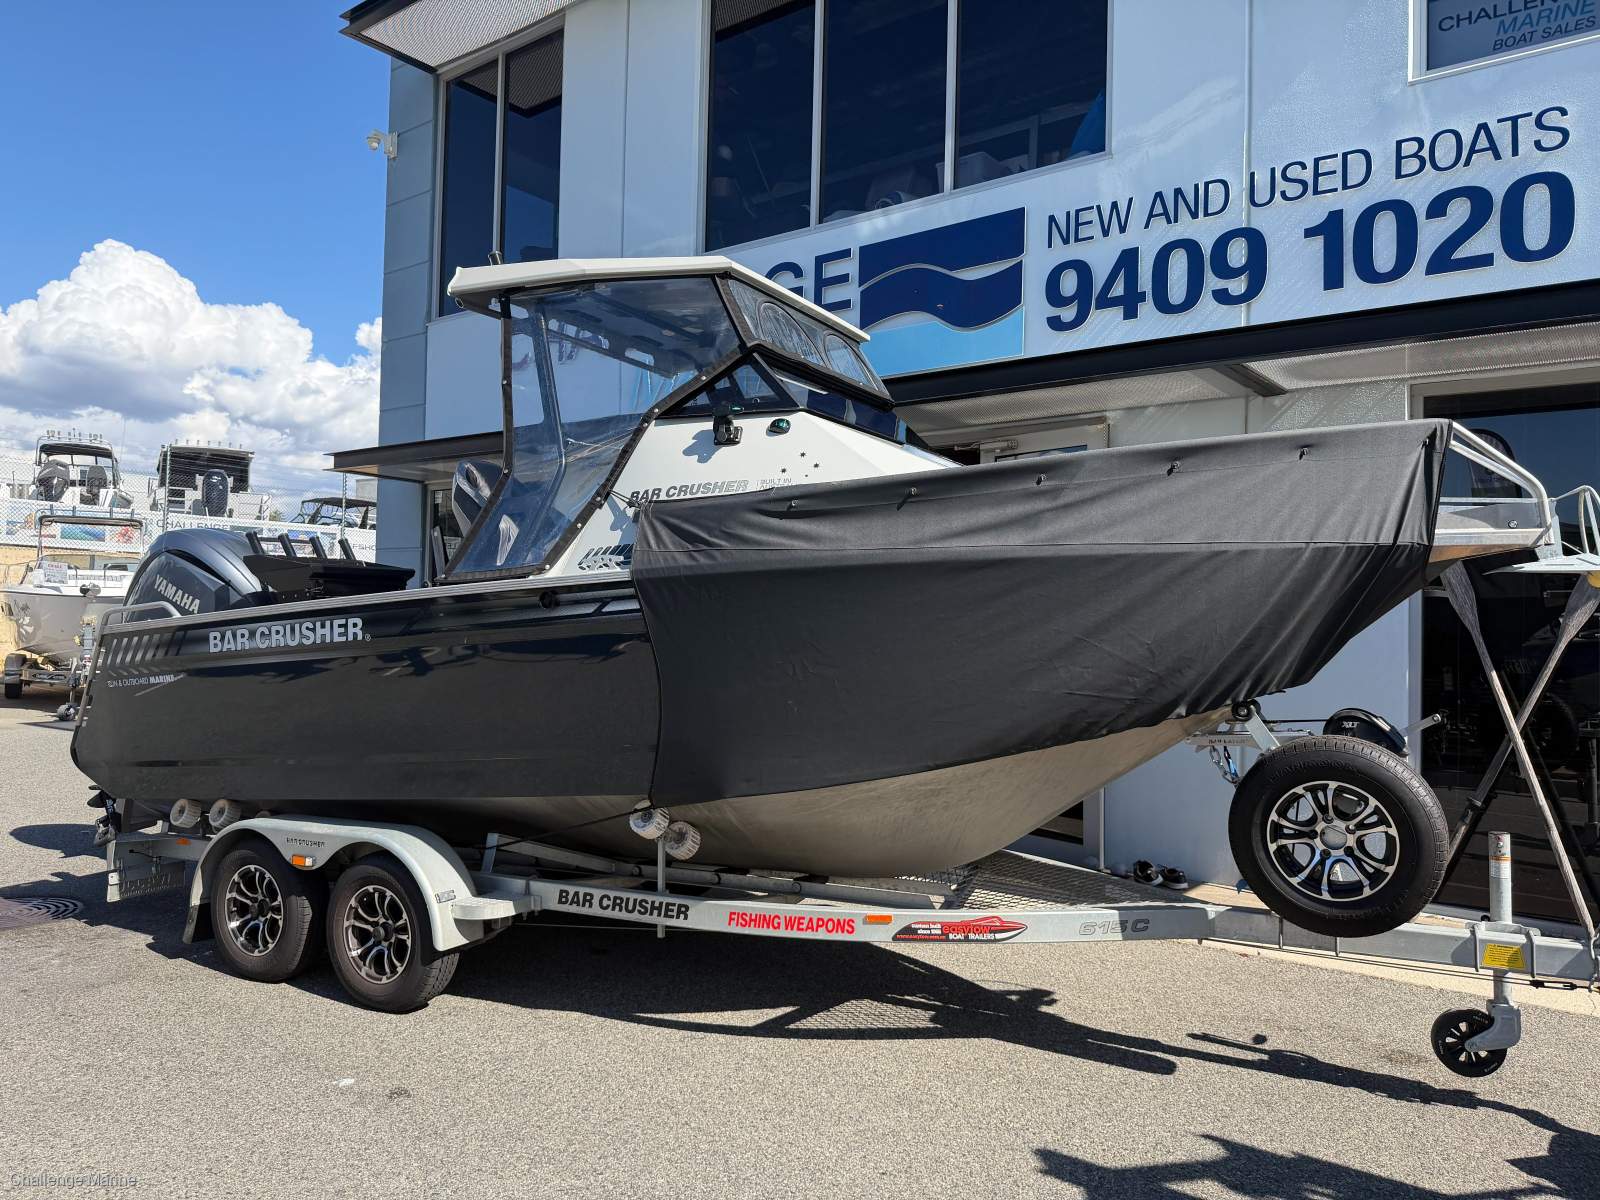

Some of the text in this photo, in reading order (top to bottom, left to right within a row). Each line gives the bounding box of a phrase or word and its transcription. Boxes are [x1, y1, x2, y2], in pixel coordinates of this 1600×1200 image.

[1492, 15, 1596, 51] BOAT SALES
[1496, 0, 1596, 35] MARINE
[1047, 106, 1571, 249] NEW AND USED BOATS
[1045, 171, 1576, 331] 9409 1020
[630, 487, 661, 501] BAR
[665, 479, 749, 497] CRUSHER
[154, 574, 200, 614] YAMAHA
[208, 617, 363, 653] BAR CRUSHER
[149, 675, 174, 684] MARINE
[557, 889, 855, 935] BAR CRUSHER FISHING WEAPONS
